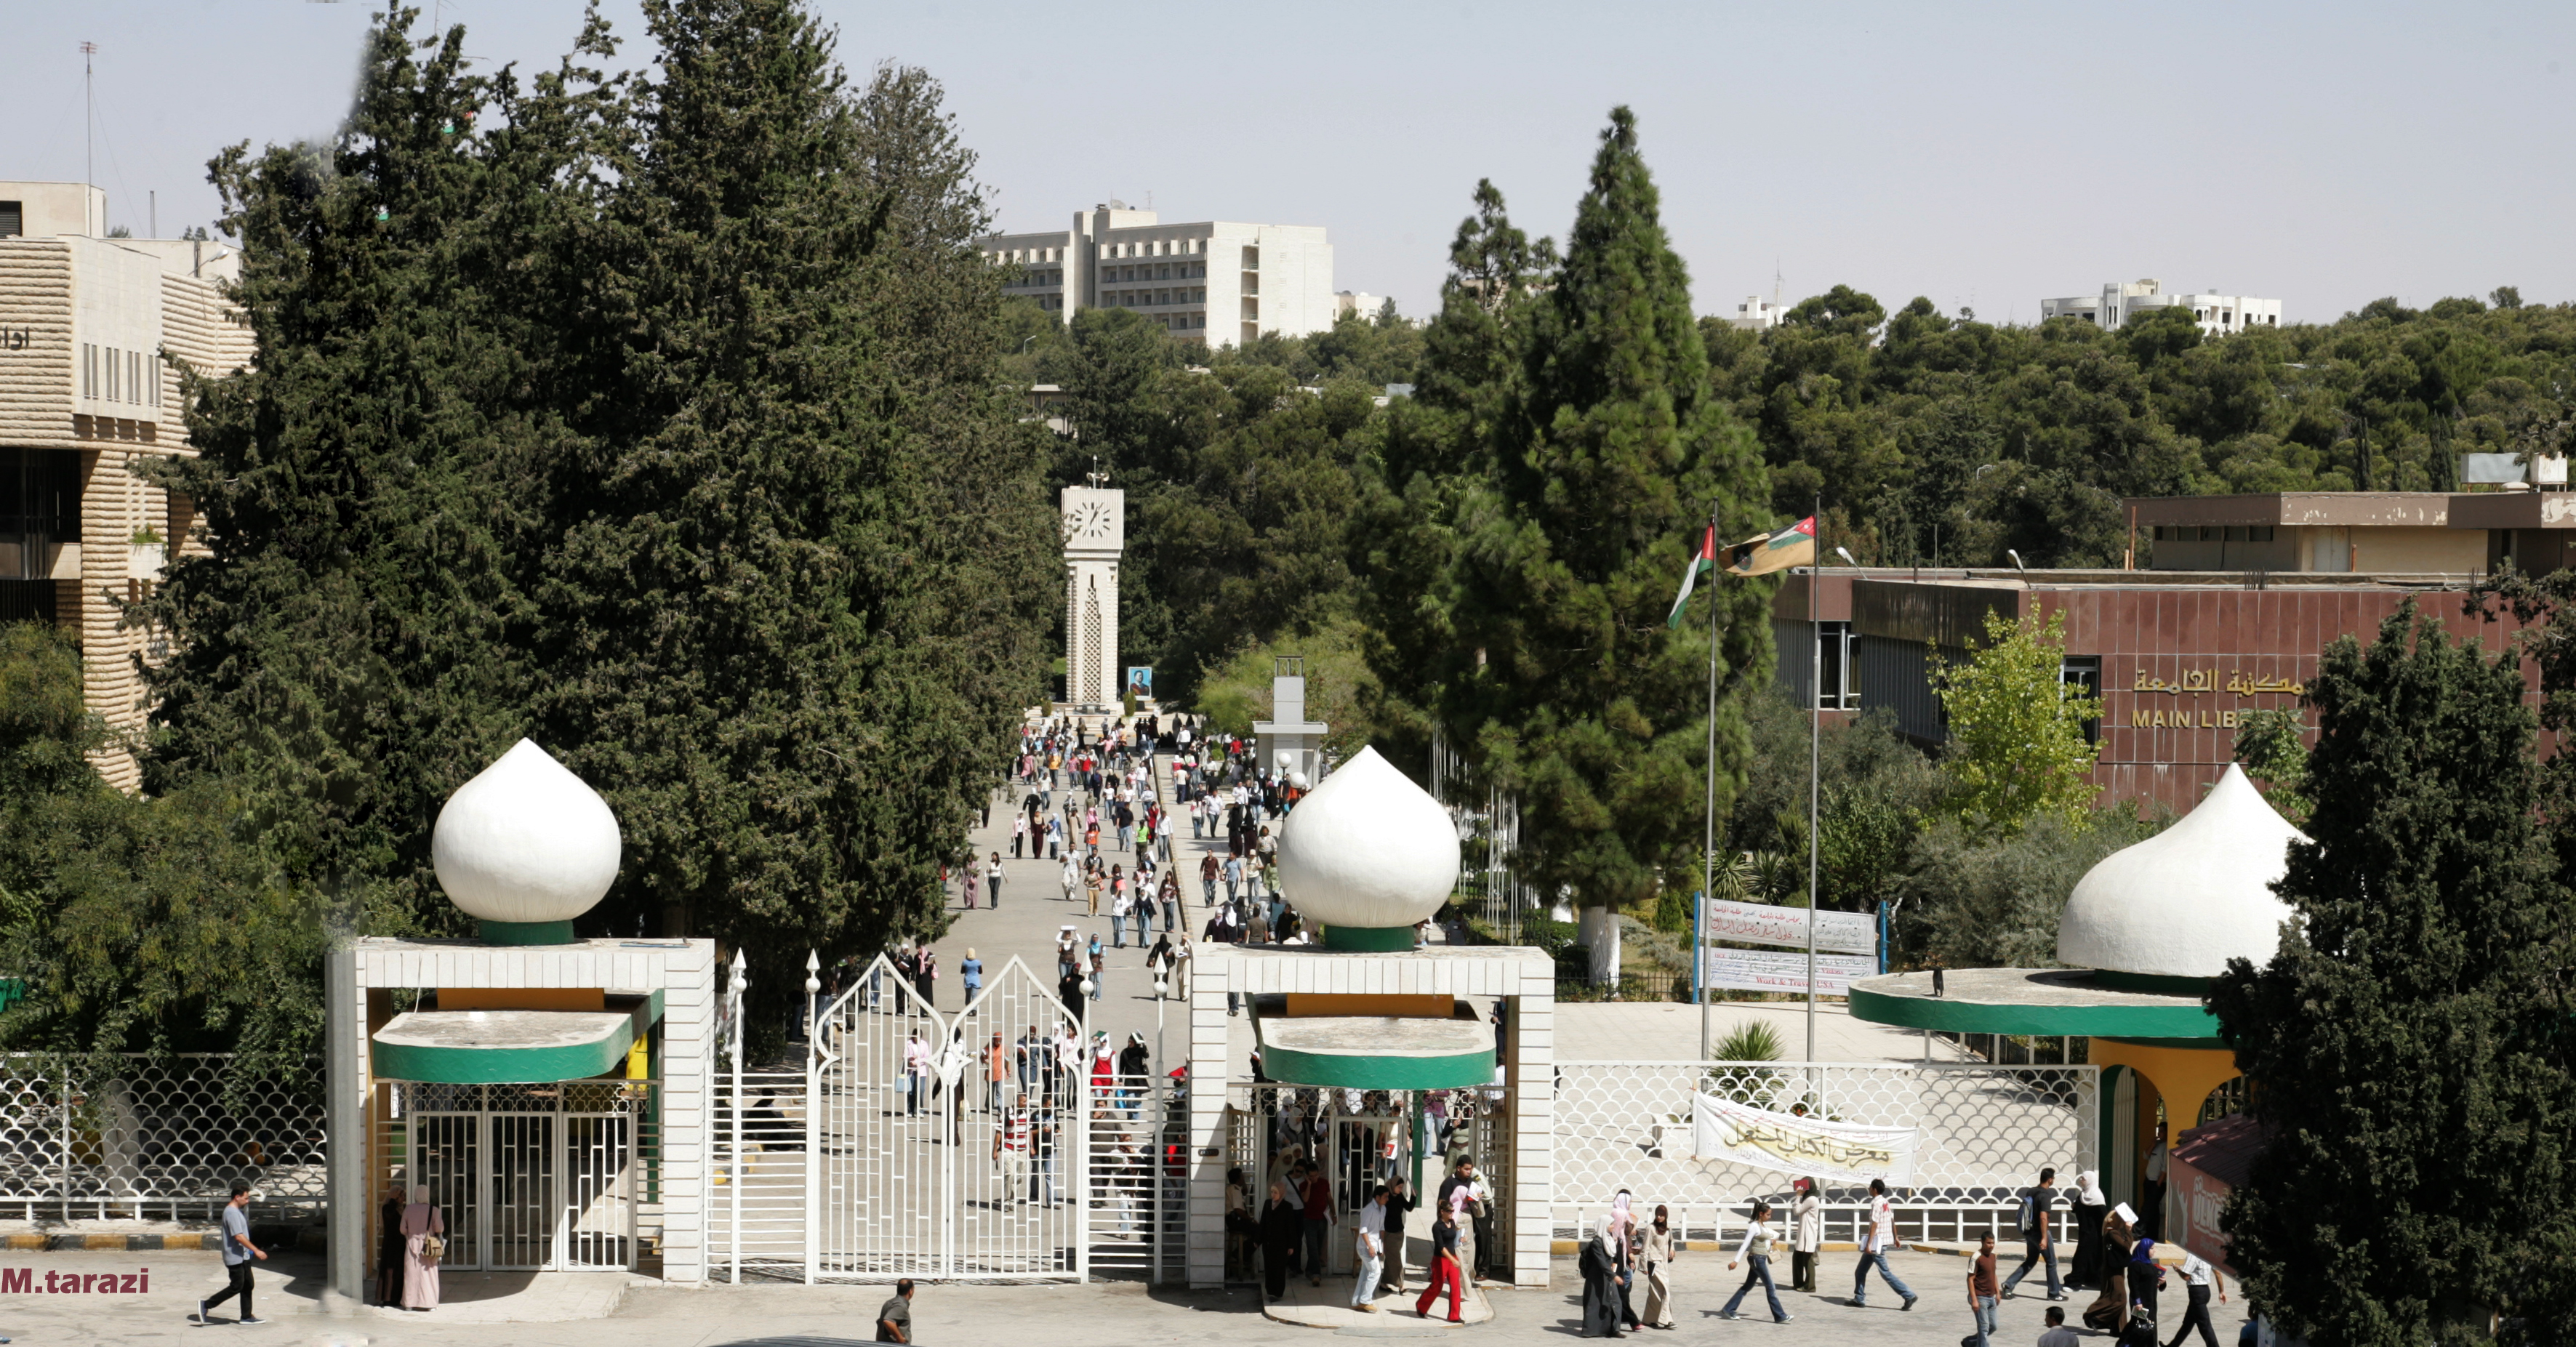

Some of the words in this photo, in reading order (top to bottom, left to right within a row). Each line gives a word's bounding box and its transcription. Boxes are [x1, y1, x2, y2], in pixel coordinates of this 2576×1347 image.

[2133, 668, 2220, 698] الجامعة
[2226, 669, 2305, 699] مكتبة
[2132, 709, 2190, 728] MAIN
[1816, 980, 1835, 989] USA
[1724, 1123, 1789, 1148] المستعمل
[1778, 1133, 1831, 1159] الكتاب
[1831, 1143, 1890, 1168] معرض
